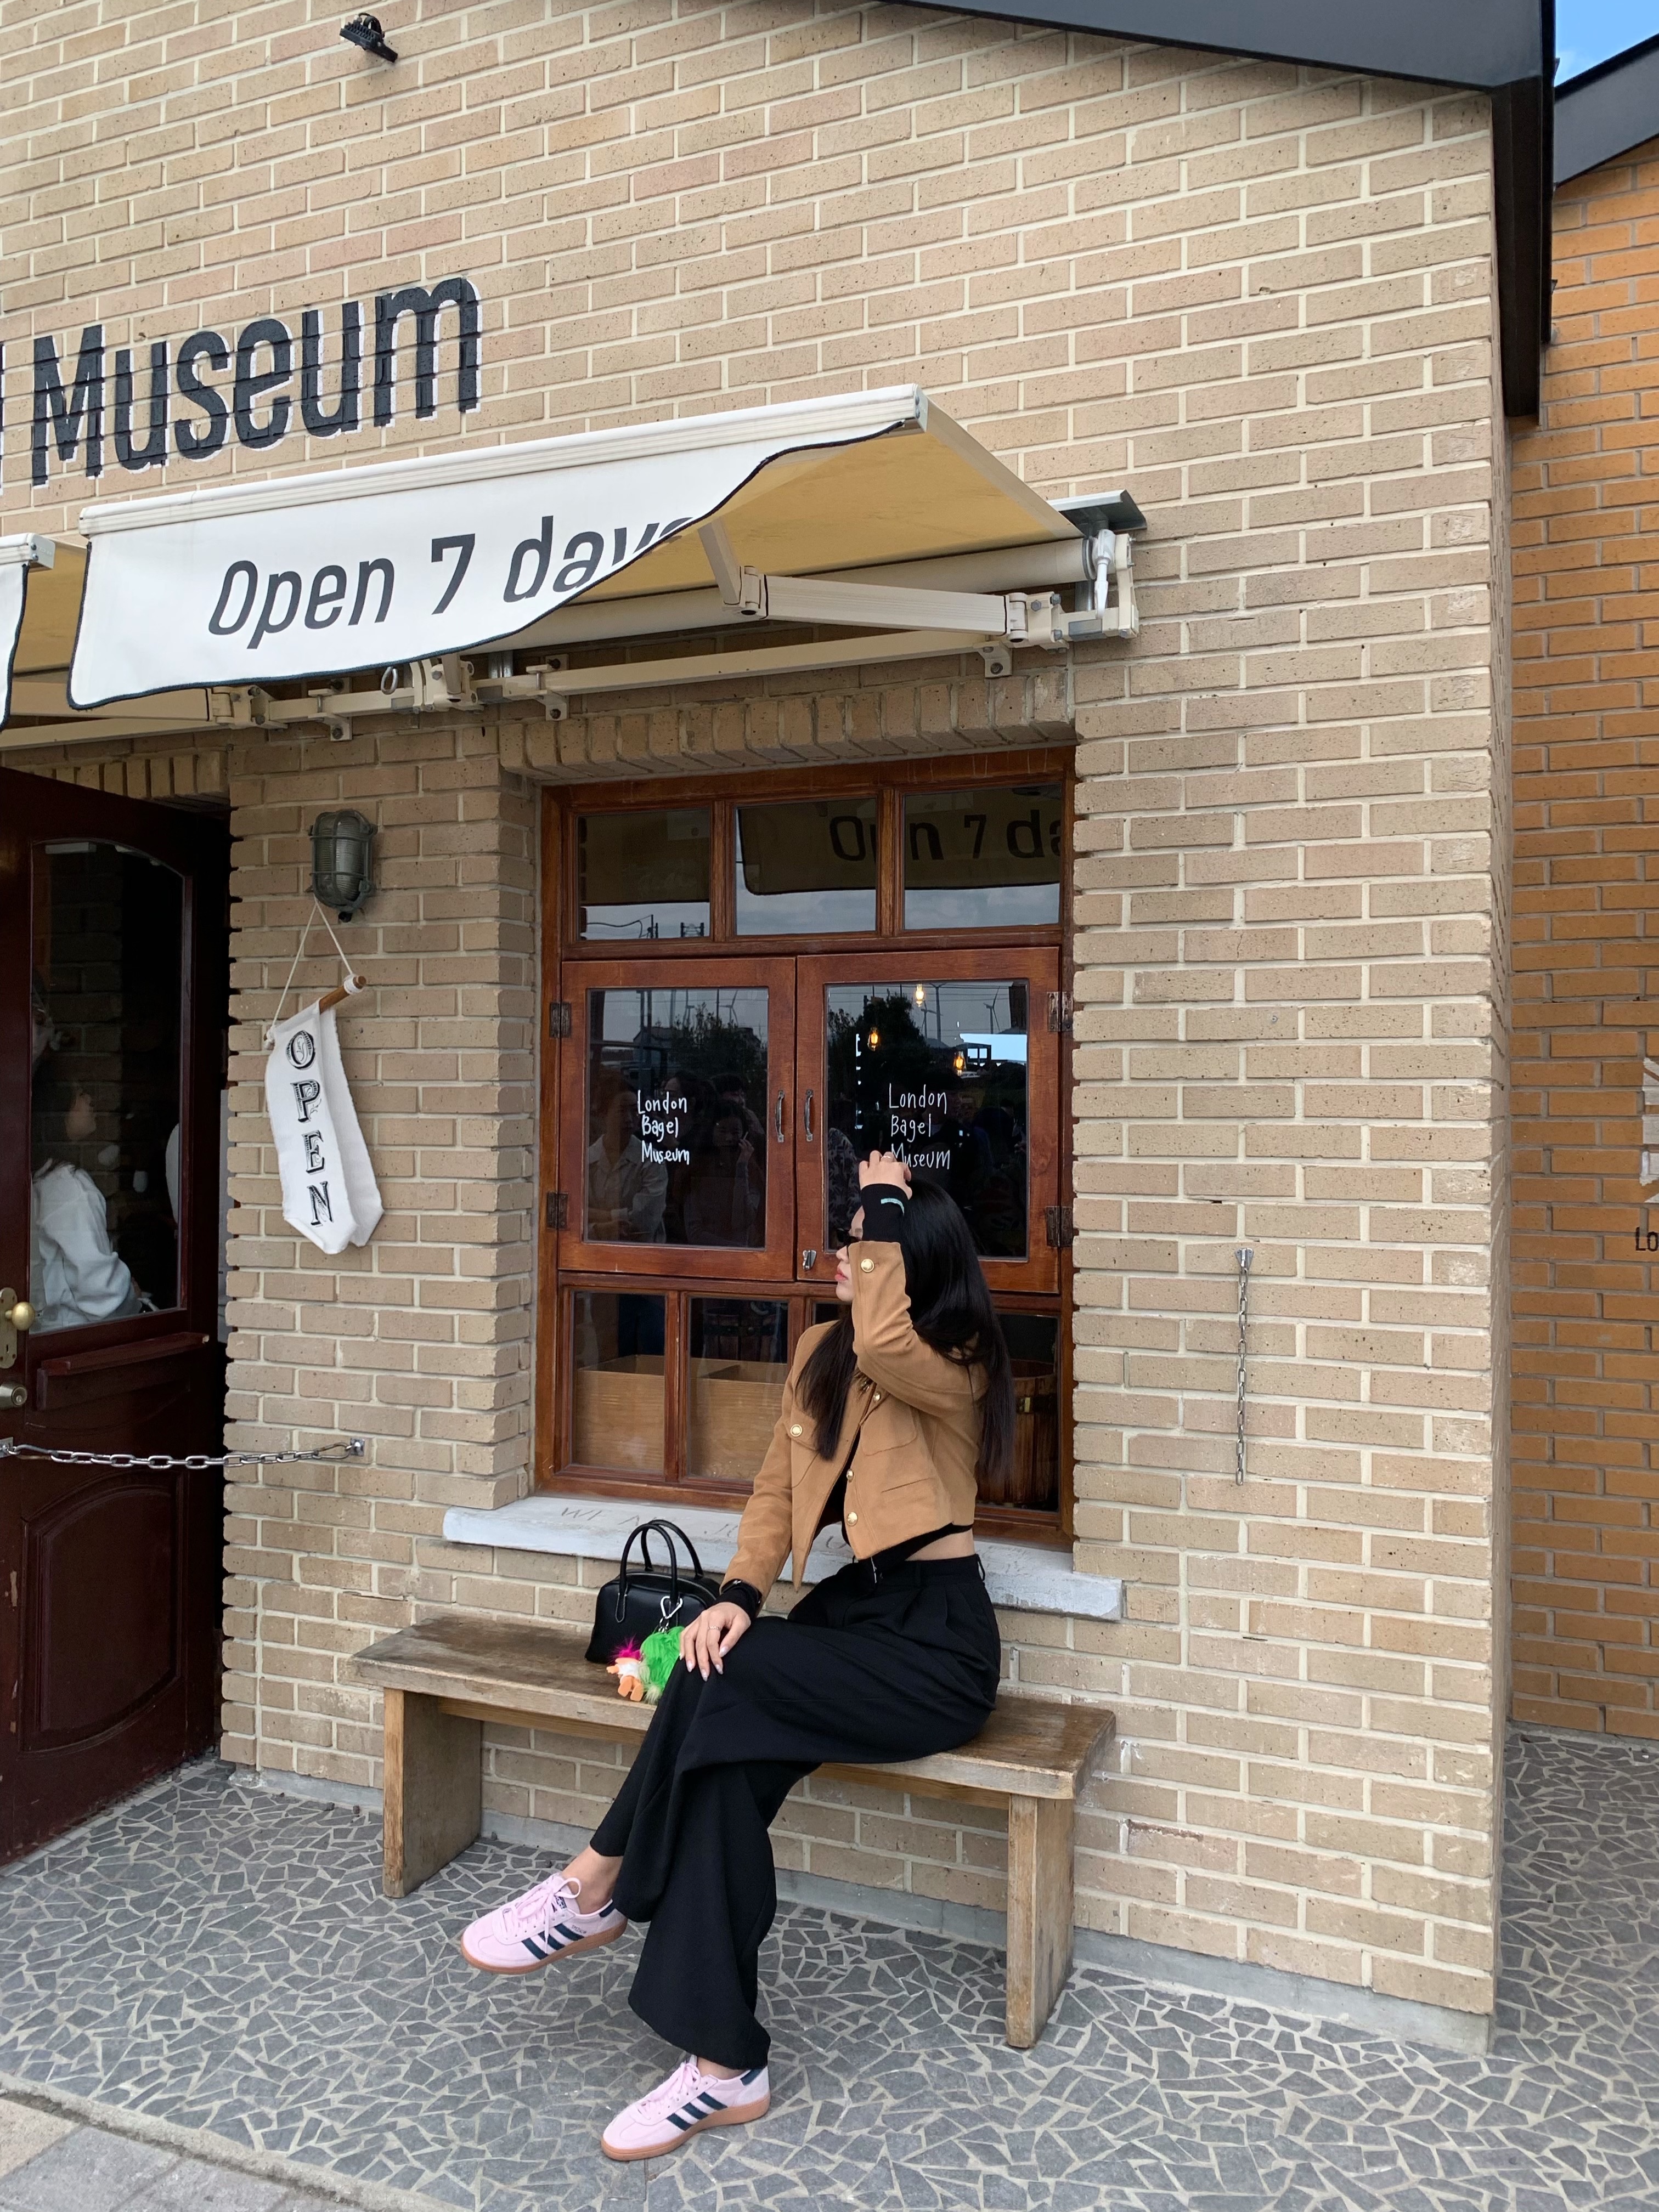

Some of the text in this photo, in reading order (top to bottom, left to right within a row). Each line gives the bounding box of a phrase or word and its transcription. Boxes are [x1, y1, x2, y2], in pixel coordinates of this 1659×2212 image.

[32, 277, 482, 489] Museum
[208, 558, 394, 649] Open
[431, 533, 476, 615] 7
[637, 1089, 687, 1115] London
[889, 1083, 947, 1115] London
[285, 1030, 334, 1227] OPEN
[642, 1114, 679, 1142] Bagel
[891, 1113, 932, 1143] Bagel
[641, 1140, 690, 1166] Museum
